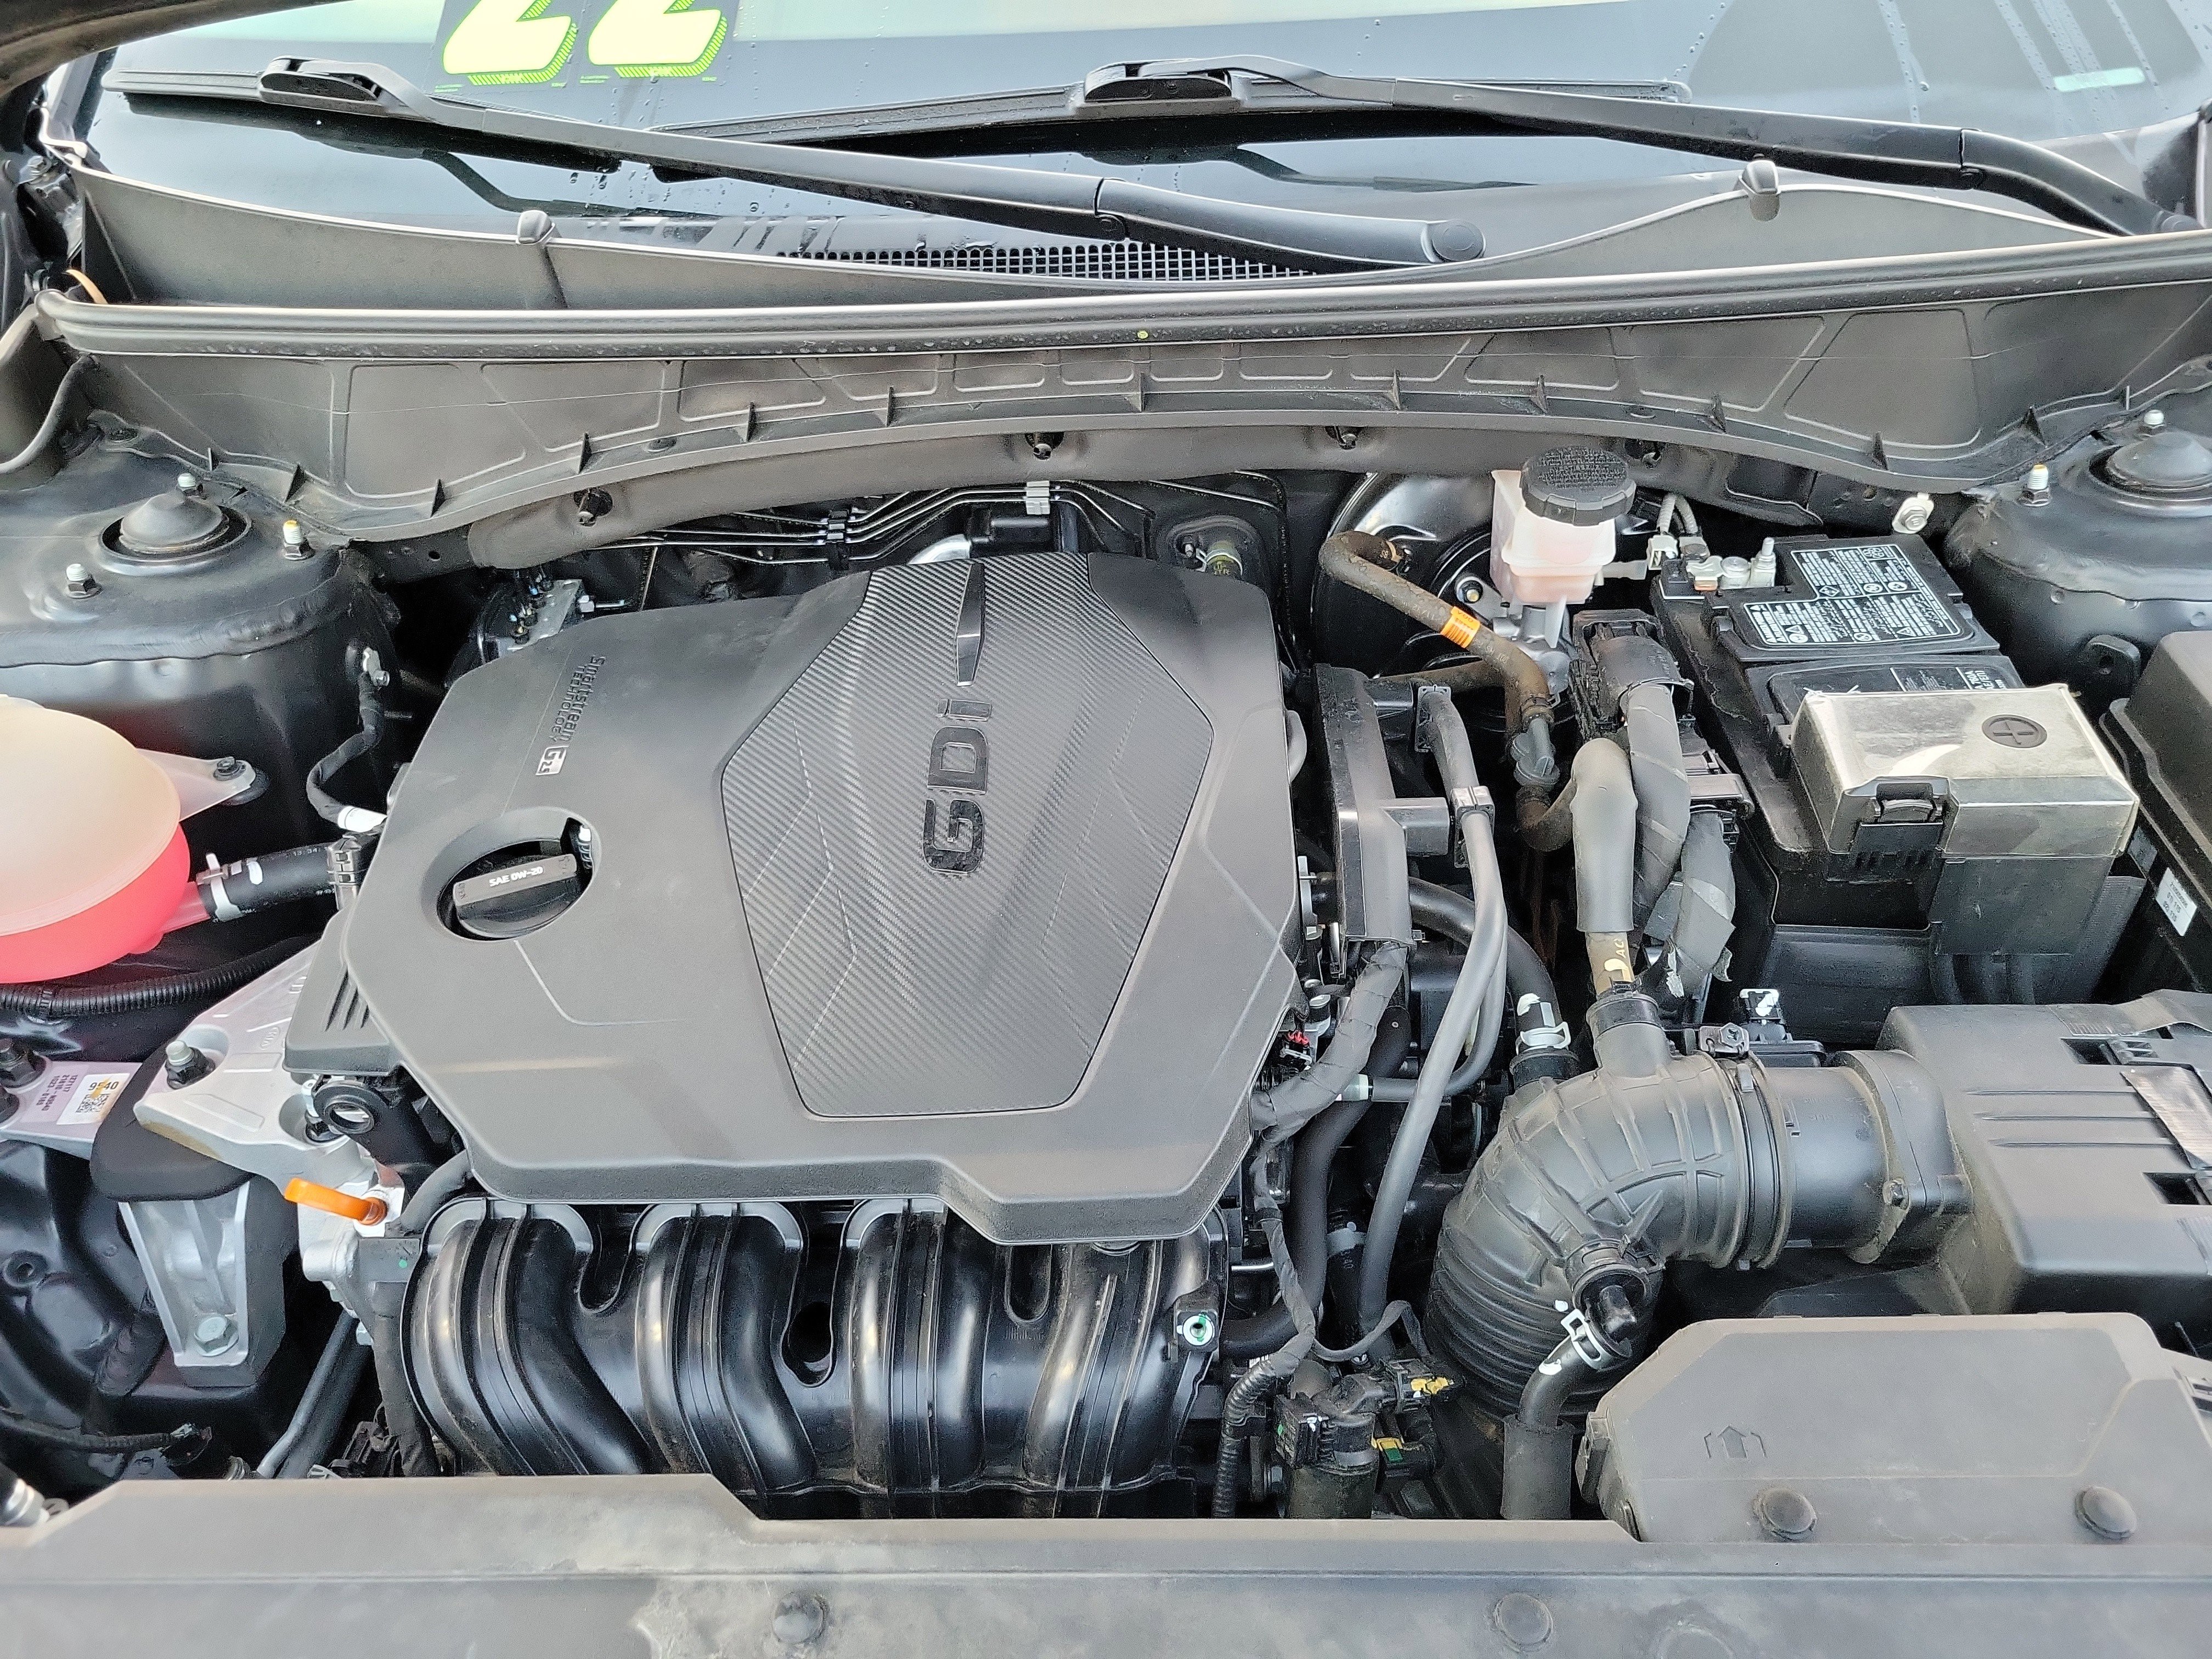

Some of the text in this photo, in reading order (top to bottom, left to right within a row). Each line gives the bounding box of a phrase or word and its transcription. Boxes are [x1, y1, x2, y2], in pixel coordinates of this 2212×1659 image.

[560, 654, 606, 743] Smartstream
[489, 866, 543, 887] SAE 0W-20
